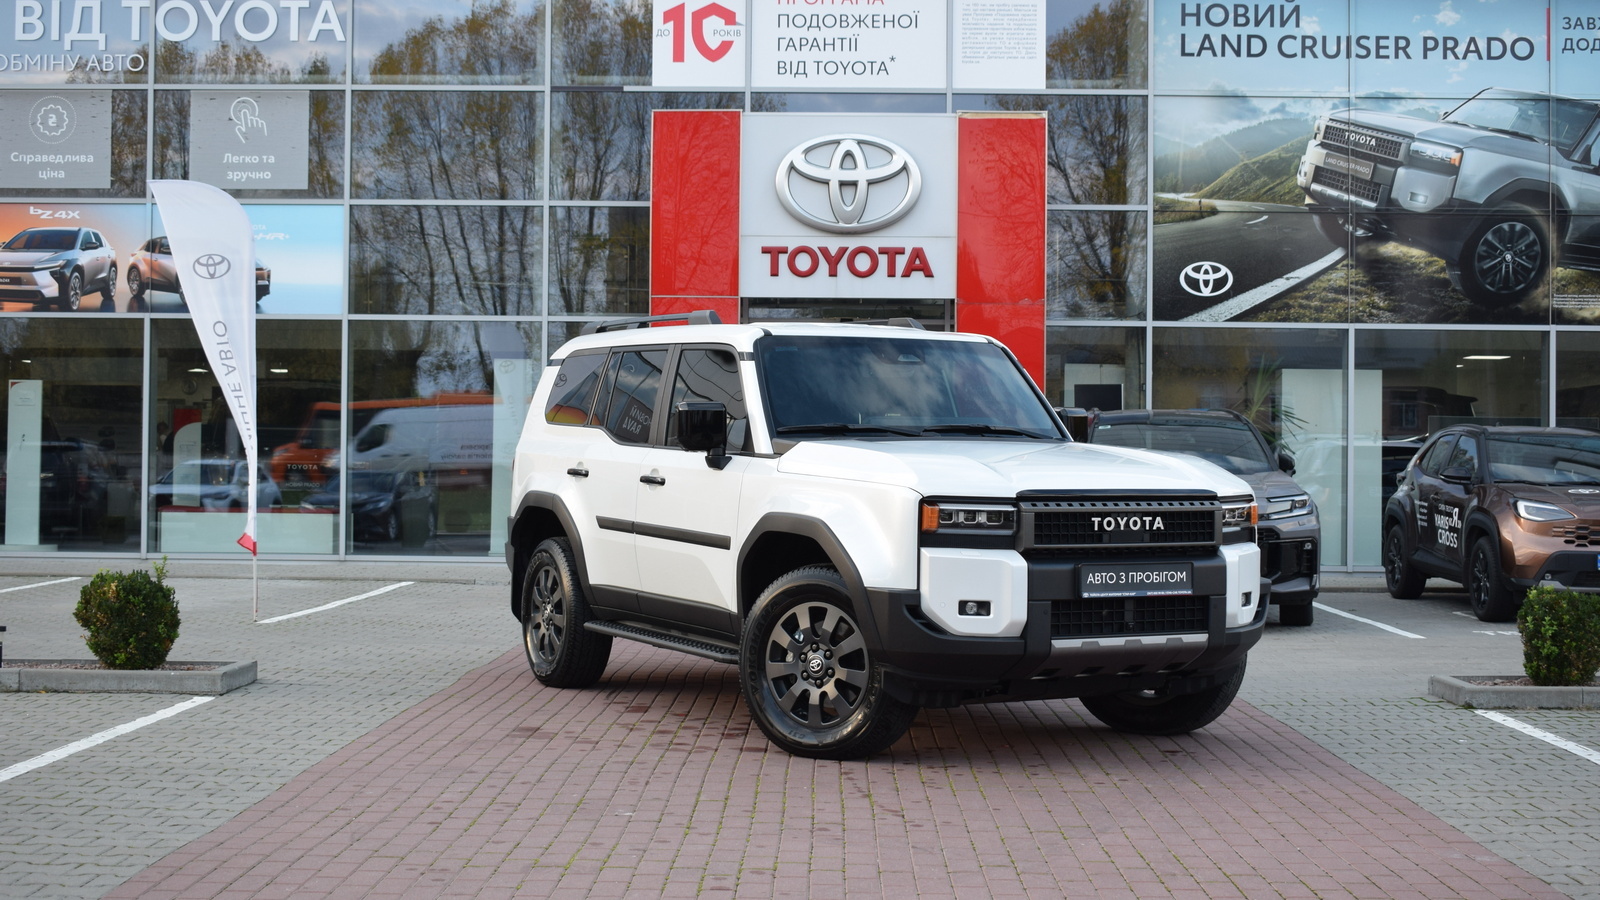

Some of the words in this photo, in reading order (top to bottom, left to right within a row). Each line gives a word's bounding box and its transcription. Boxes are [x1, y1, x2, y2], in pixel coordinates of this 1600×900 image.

[777, 10, 920, 31] ПОДОВЖЕНОЇ
[1180, 0, 1301, 28] НОВИЙ
[15, 0, 107, 51] ВІД
[121, 0, 347, 42] TOYOTA
[656, 29, 671, 38] ДО
[713, 29, 742, 38] РОКІВ
[777, 33, 859, 52] ГАРАНТІЇ
[1180, 33, 1268, 58] LAND
[1276, 34, 1412, 60] CRUISER
[1422, 36, 1535, 61] PRADO
[86, 53, 145, 72] АВТО
[777, 60, 808, 79] ВІД
[1344, 132, 1376, 145] TOYOTA
[10, 152, 95, 165] Справедлива
[222, 153, 260, 166] Легко
[262, 154, 276, 165] та
[38, 168, 65, 180] ціна
[227, 169, 272, 181] зручно
[761, 245, 935, 279] TOYOTA
[1092, 517, 1164, 531] TOYOTA
[1434, 513, 1449, 530] YARIS
[1438, 529, 1458, 548] CROSS
[1087, 572, 1117, 584] АВТО
[1119, 572, 1126, 584] З
[1129, 571, 1186, 583] ПРОБІГОМ
